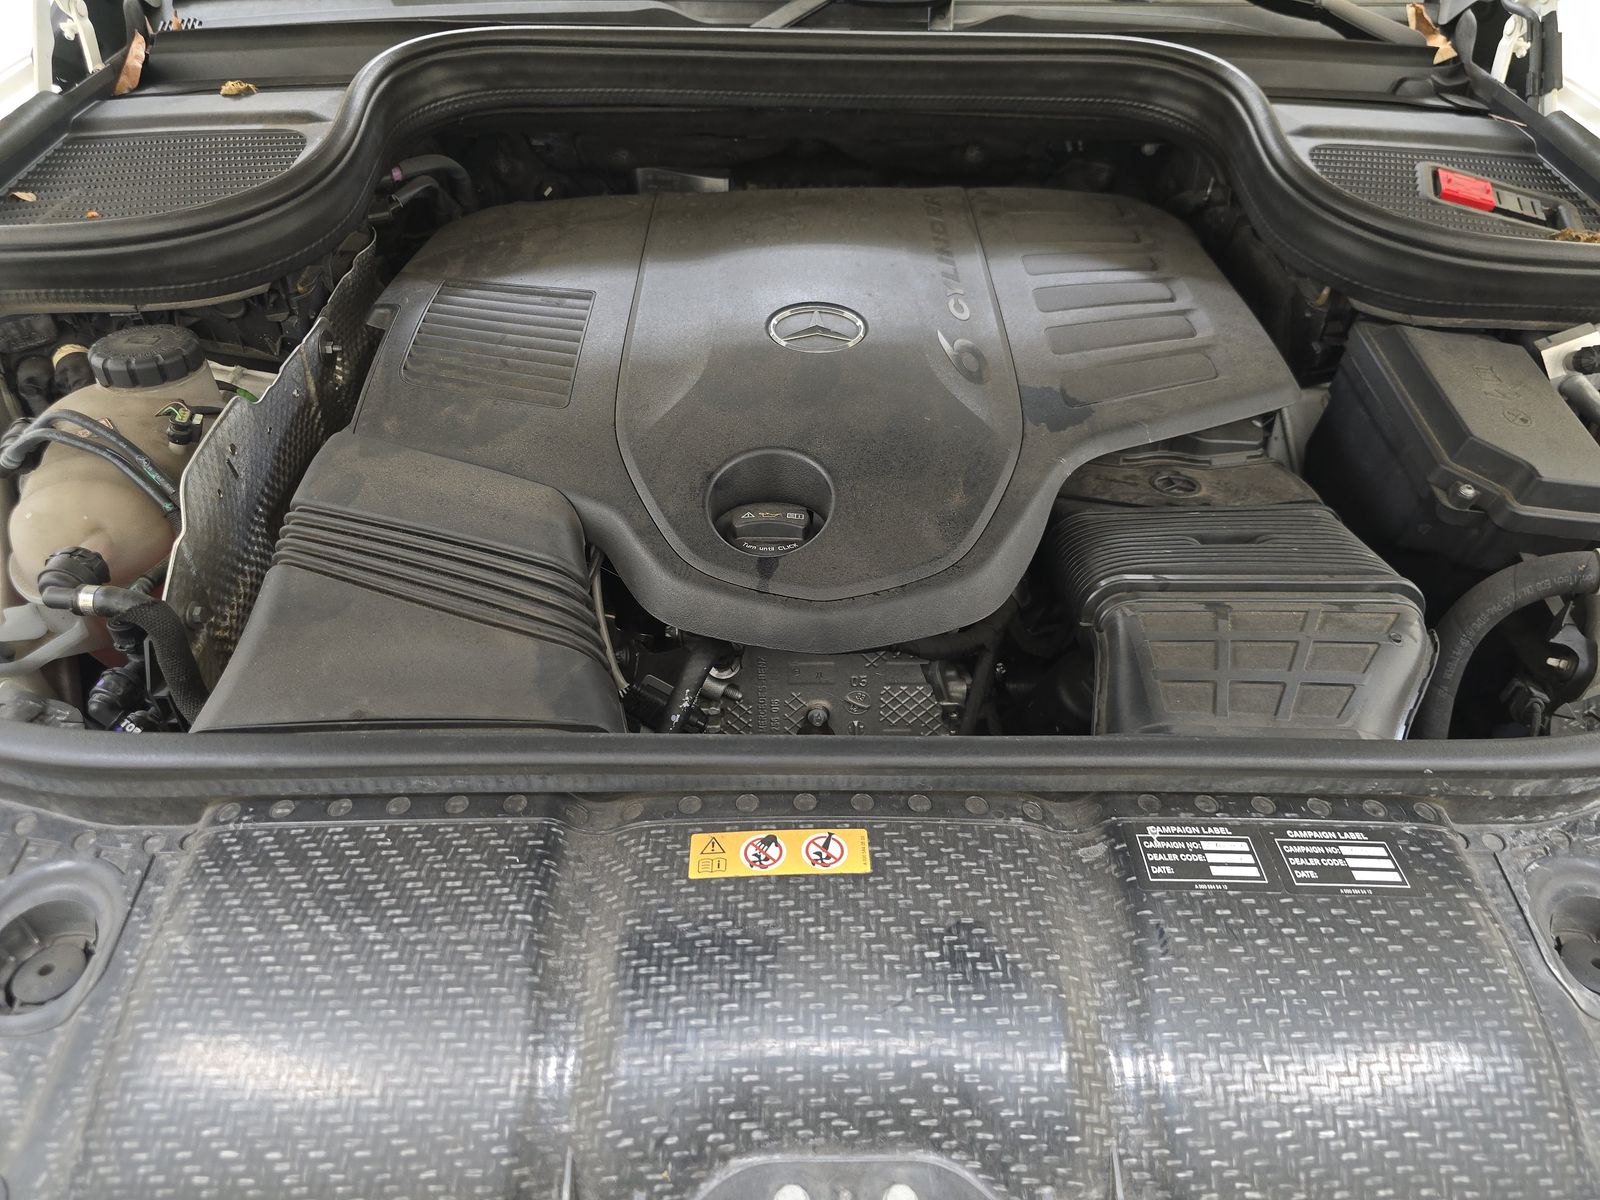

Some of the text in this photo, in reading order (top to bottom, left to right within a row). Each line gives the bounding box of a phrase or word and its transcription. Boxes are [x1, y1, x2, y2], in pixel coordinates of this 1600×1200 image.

[923, 193, 991, 386] 6 CYLINDER
[778, 543, 799, 551] CLICK
[120, 718, 143, 733] TOP
[1147, 825, 1232, 835] CAMPAIGN LABEL
[1286, 830, 1369, 840] CAMPAIGN LABEL
[1143, 840, 1186, 850] CAMPAIGN
[1185, 841, 1202, 850] NO:
[1283, 845, 1341, 854] CAMPAIGN NO:
[1146, 853, 1207, 862] DEALER CODE:
[1288, 857, 1348, 867] DEALER CODE:
[1150, 865, 1175, 874] DATE:
[1294, 869, 1319, 879] DATE:
